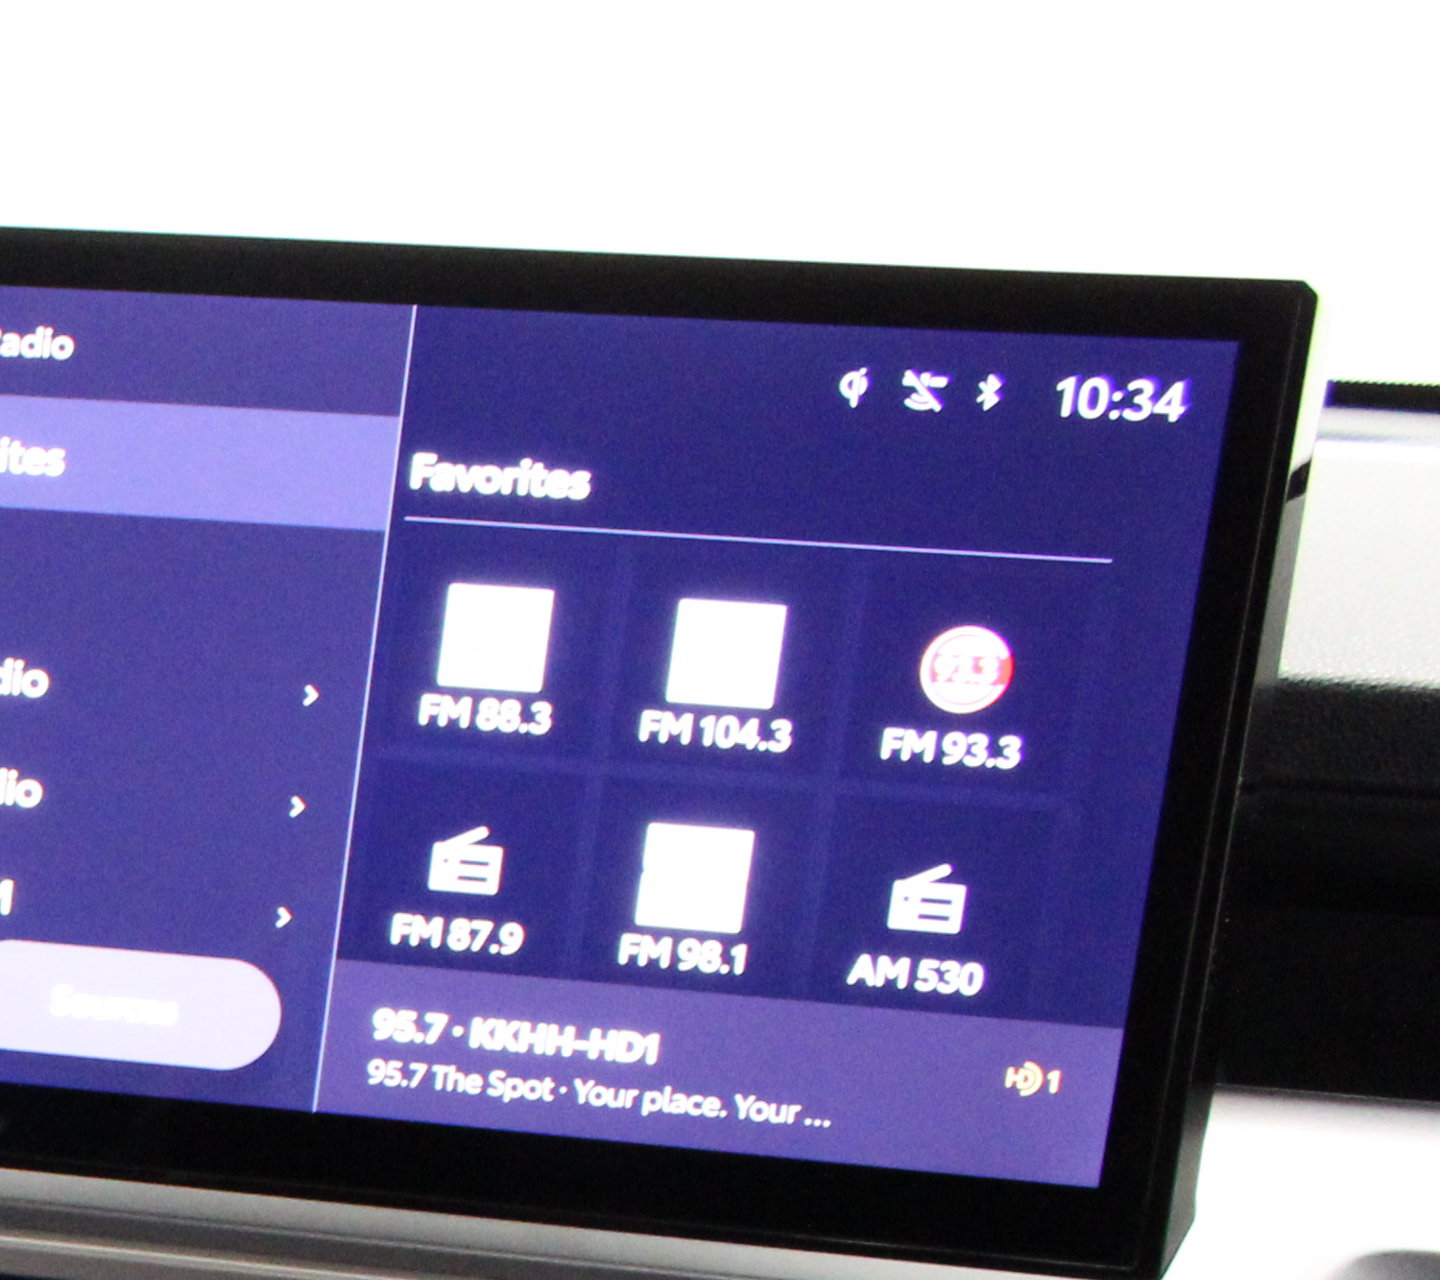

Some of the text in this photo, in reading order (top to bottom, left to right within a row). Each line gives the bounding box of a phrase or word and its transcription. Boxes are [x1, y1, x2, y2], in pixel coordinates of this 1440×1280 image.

[1056, 374, 1191, 423] 10:34
[409, 452, 592, 500] Favorites
[418, 693, 553, 734] FM 88.3
[638, 710, 793, 753] FM 104.3
[880, 727, 1024, 769] FM 93.3
[390, 913, 525, 955] FM 87.9
[618, 933, 748, 975] FM 98.1
[846, 953, 984, 996] AM 530
[372, 1008, 448, 1044] 95.7
[367, 1059, 427, 1088] 95.7
[432, 1065, 483, 1096] The
[488, 1069, 556, 1103] Spot
[574, 1078, 640, 1110] Your
[641, 1085, 727, 1118] place.
[734, 1093, 803, 1125] Your
